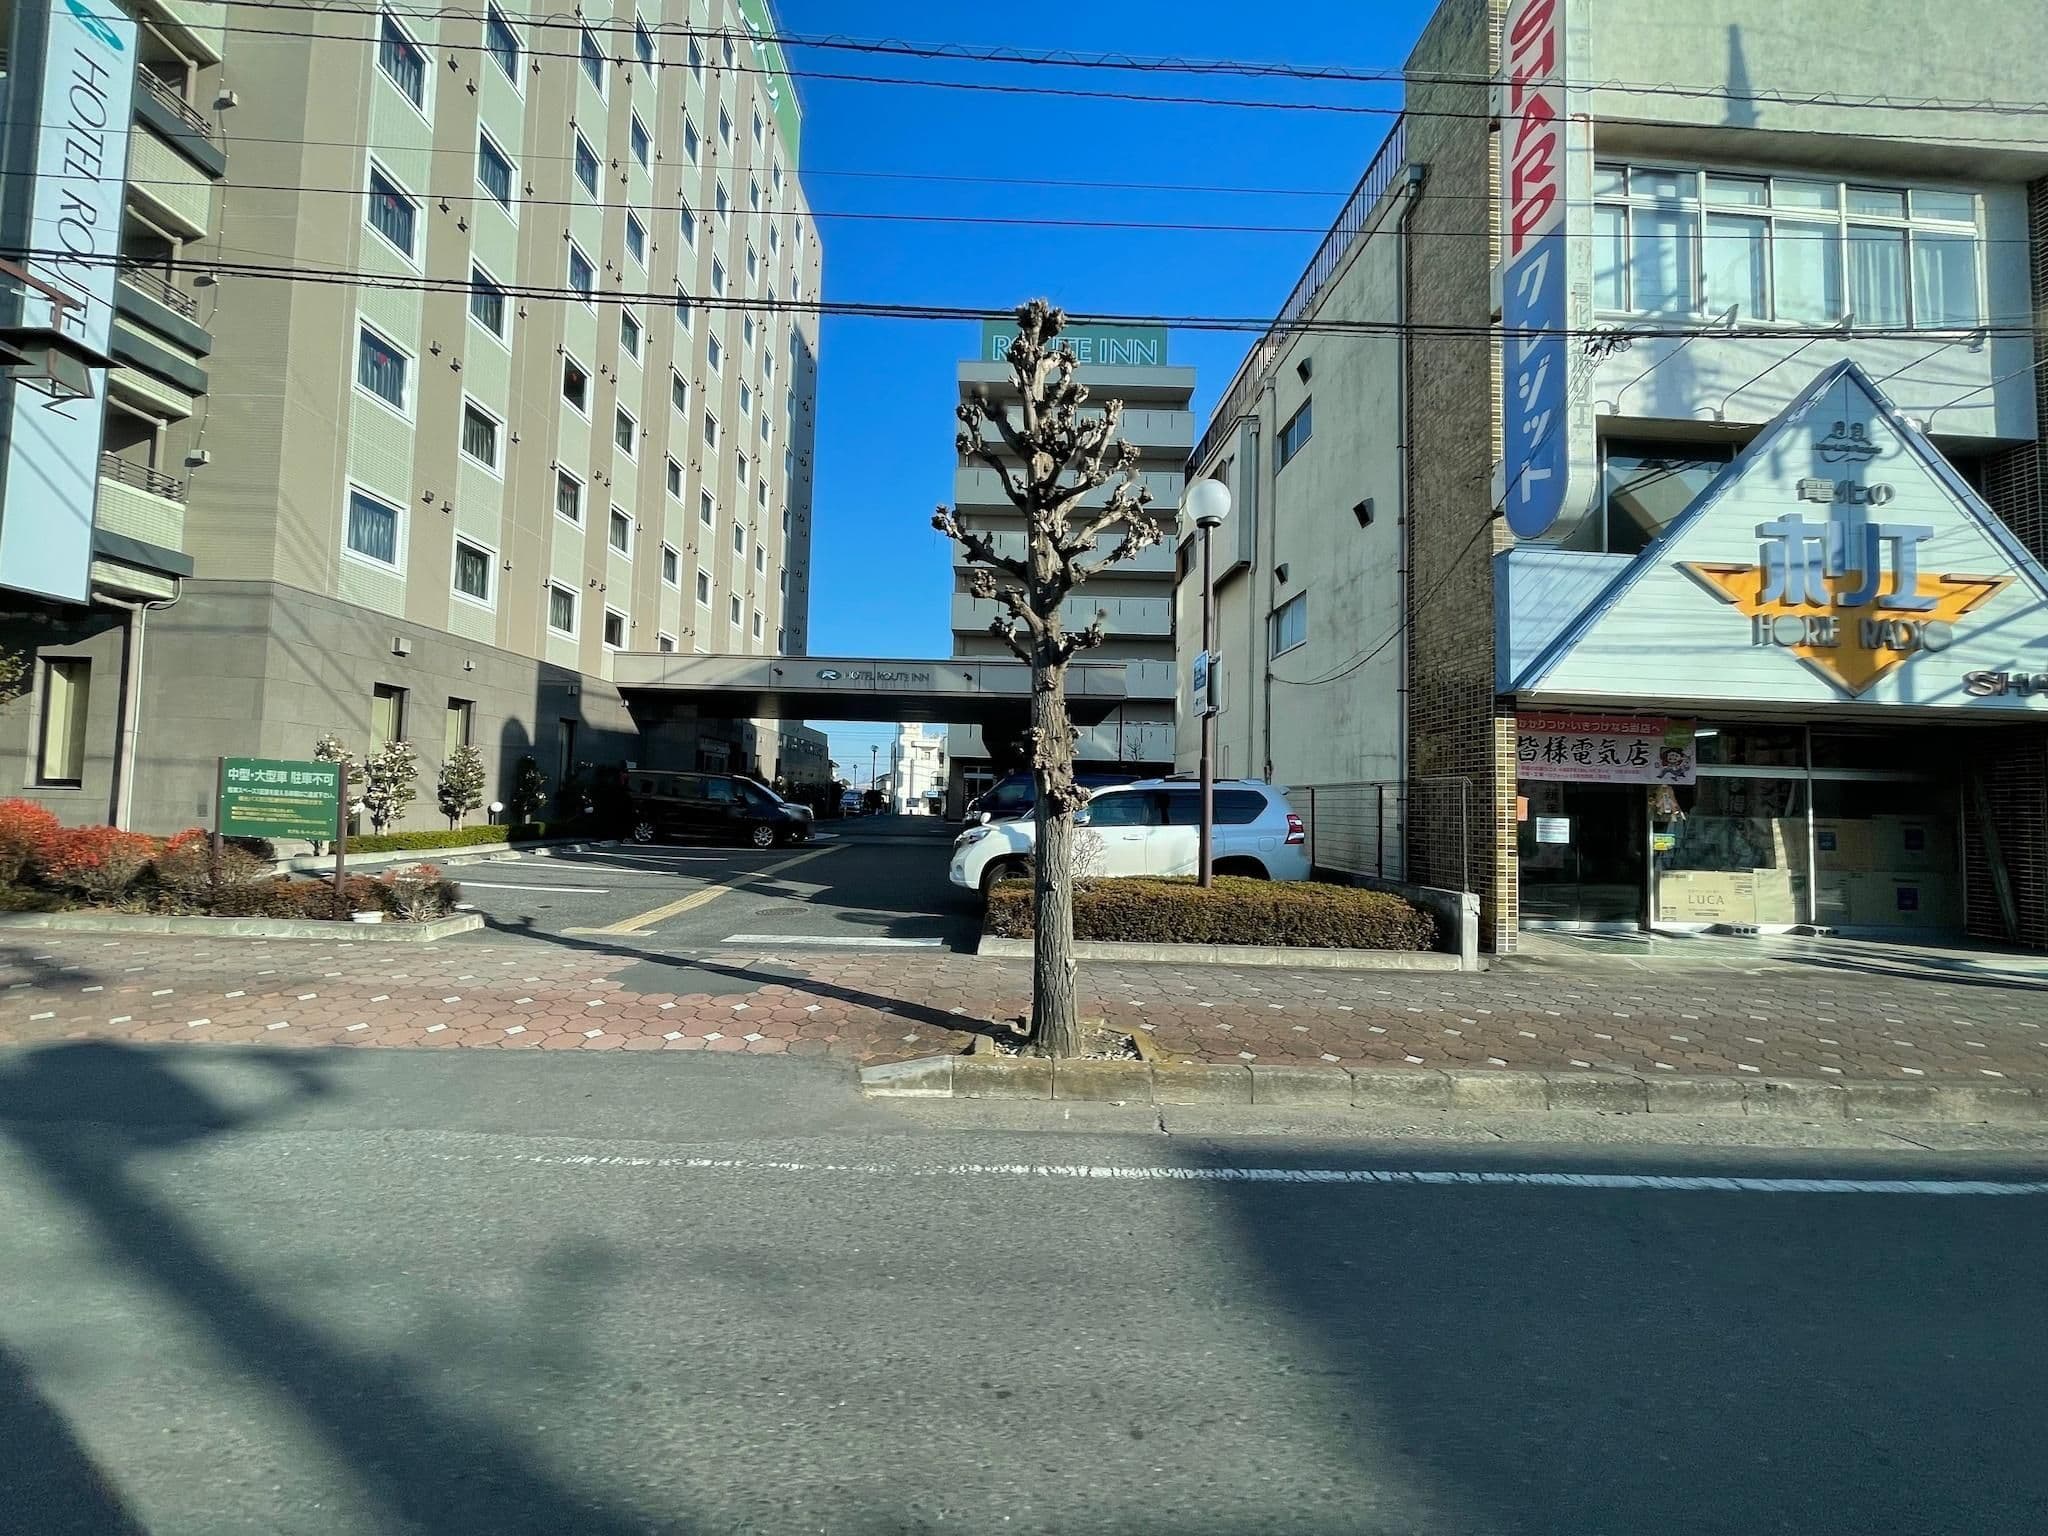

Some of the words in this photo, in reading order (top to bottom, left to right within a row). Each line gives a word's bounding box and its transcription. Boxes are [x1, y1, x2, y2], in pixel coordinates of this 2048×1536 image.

[64, 48, 110, 183] HOTEL
[1510, 0, 1556, 258] SHARP
[1100, 338, 1158, 365] INN
[1516, 249, 1552, 504] クレジット
[1796, 478, 1896, 506] 電化の
[1755, 513, 1939, 611] ホリエ
[1752, 613, 1841, 648] HORIE
[1859, 617, 1953, 652] RADIO
[1516, 735, 1651, 767] 皆様電気店
[290, 771, 335, 786] 駐車不可
[1688, 895, 1725, 905] LUCA
